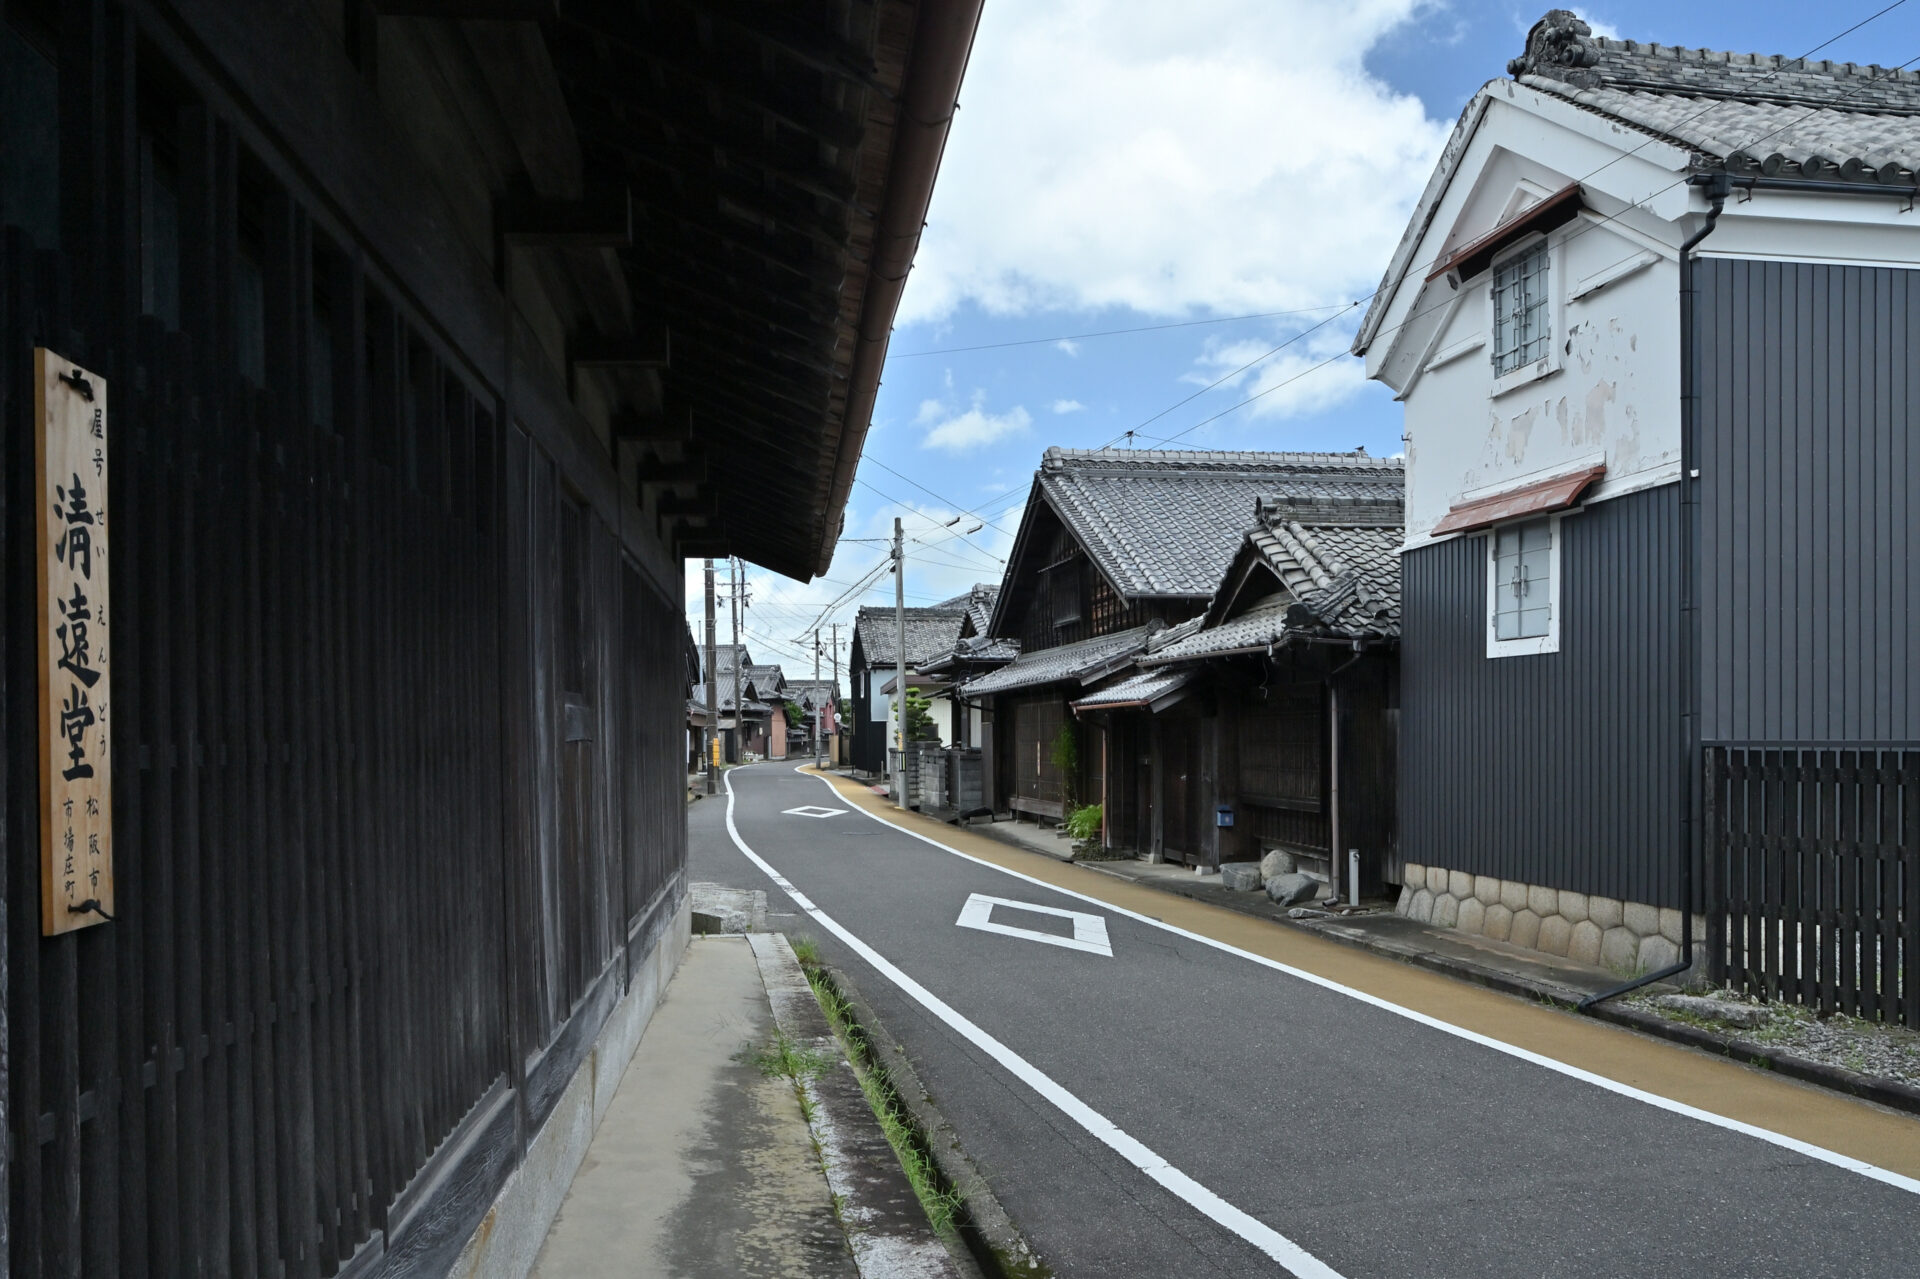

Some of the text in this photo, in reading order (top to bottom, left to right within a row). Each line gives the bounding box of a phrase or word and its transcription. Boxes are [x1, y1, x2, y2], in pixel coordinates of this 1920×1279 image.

[91, 408, 104, 477] 屋号
[63, 797, 75, 901] 市場庄町
[86, 794, 100, 897] 松阪市
